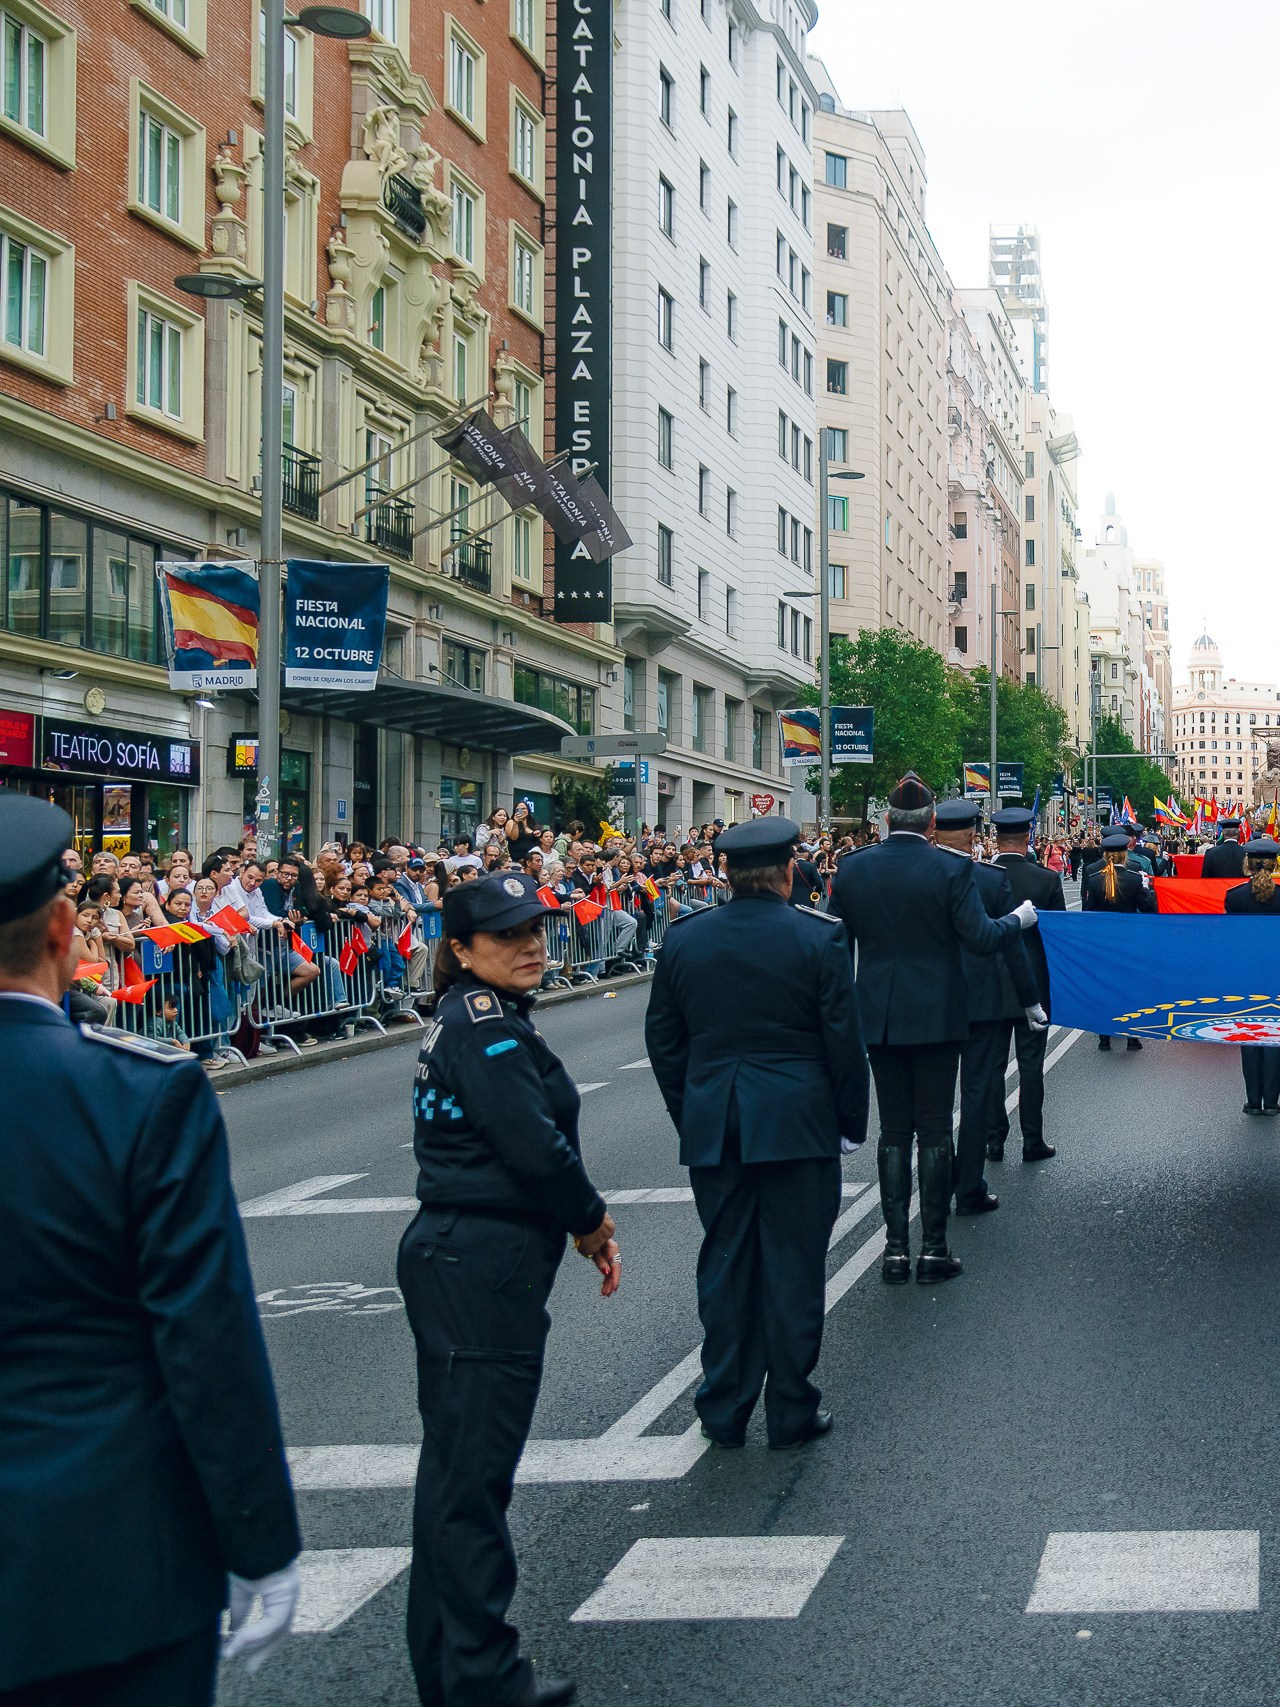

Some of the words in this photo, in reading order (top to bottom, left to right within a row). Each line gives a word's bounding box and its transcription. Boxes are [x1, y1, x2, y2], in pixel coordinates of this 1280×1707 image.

[571, 0, 594, 226] CATALONIA
[570, 247, 593, 371] PLAZA
[570, 401, 593, 560] ESPA
[296, 599, 338, 613] FIESTA
[295, 615, 366, 630] NACIONAL
[295, 647, 310, 659] 12
[313, 648, 374, 665] OCTUBRE
[205, 676, 244, 687] MADRID
[321, 676, 343, 684] CRUZAN
[51, 731, 112, 764] TEATRO
[116, 741, 161, 771] SOFÍA
